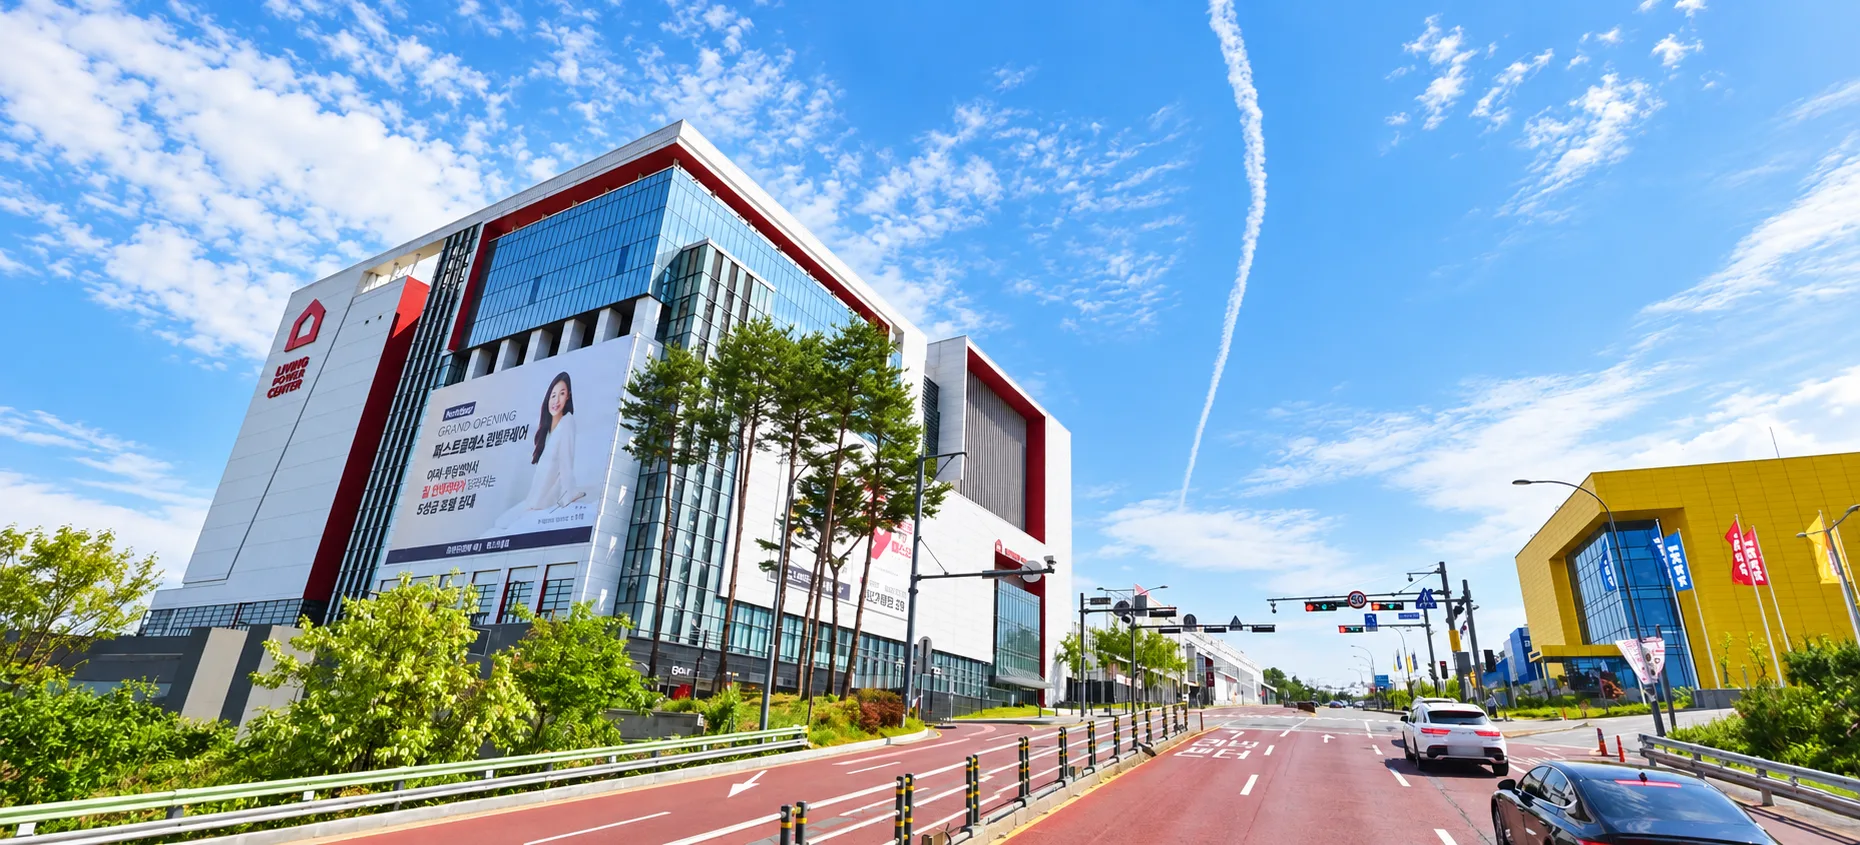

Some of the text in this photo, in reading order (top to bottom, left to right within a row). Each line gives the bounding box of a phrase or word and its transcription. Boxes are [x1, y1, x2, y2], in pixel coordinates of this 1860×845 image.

[275, 356, 310, 377] LIVING
[272, 369, 305, 386] POWER
[267, 378, 303, 399] CENTER
[438, 421, 471, 437] GRAND
[473, 410, 517, 429] OPENING
